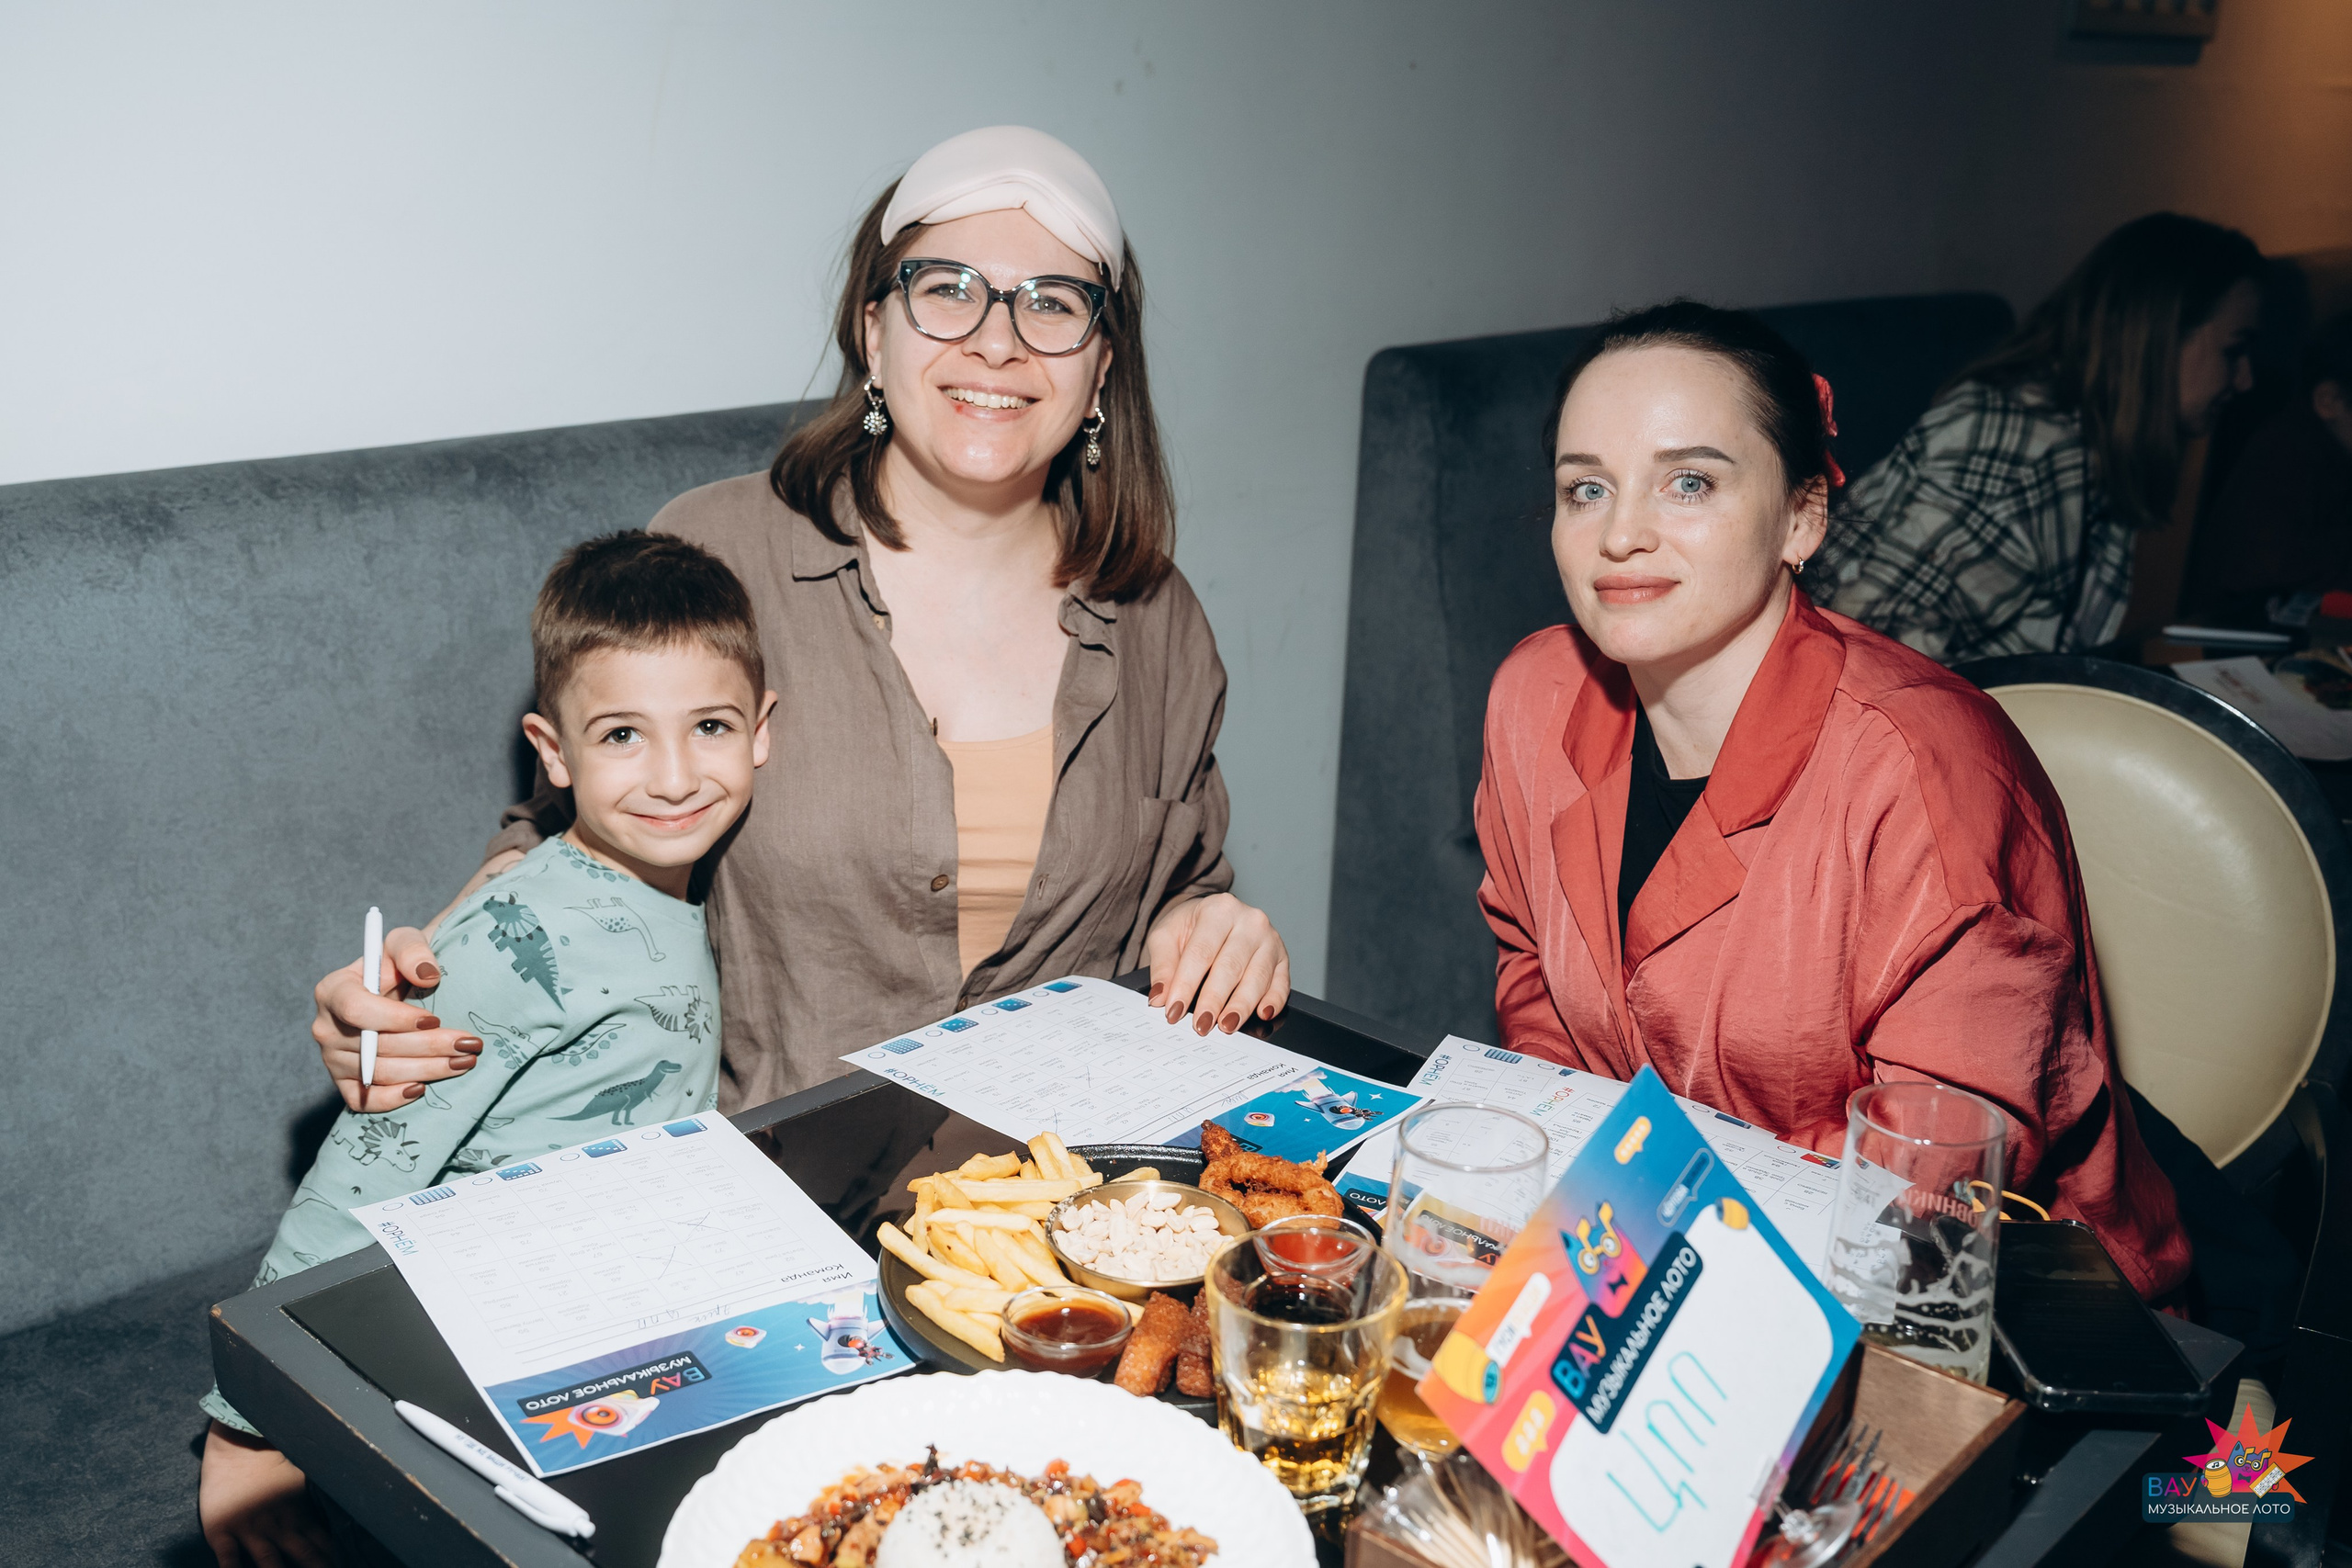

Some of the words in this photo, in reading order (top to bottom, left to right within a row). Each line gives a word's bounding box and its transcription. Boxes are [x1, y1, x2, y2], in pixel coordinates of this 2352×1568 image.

[1246, 1062, 1286, 1080] Команда
[1277, 1067, 1299, 1078] Имя
[1349, 1191, 1386, 1206] ЛОТО
[780, 1263, 844, 1282] Команда
[821, 1271, 853, 1283] Имя
[1585, 1291, 1669, 1424] МУЗЫКАЛЬНОЕ
[1660, 1247, 1697, 1301] ЛОТО
[1553, 1314, 1606, 1399] ВАУ
[571, 1356, 693, 1398] МУЗЫКАЛЬНОЕ
[650, 1366, 706, 1395] ВАУ
[526, 1392, 570, 1411] ЛОТО
